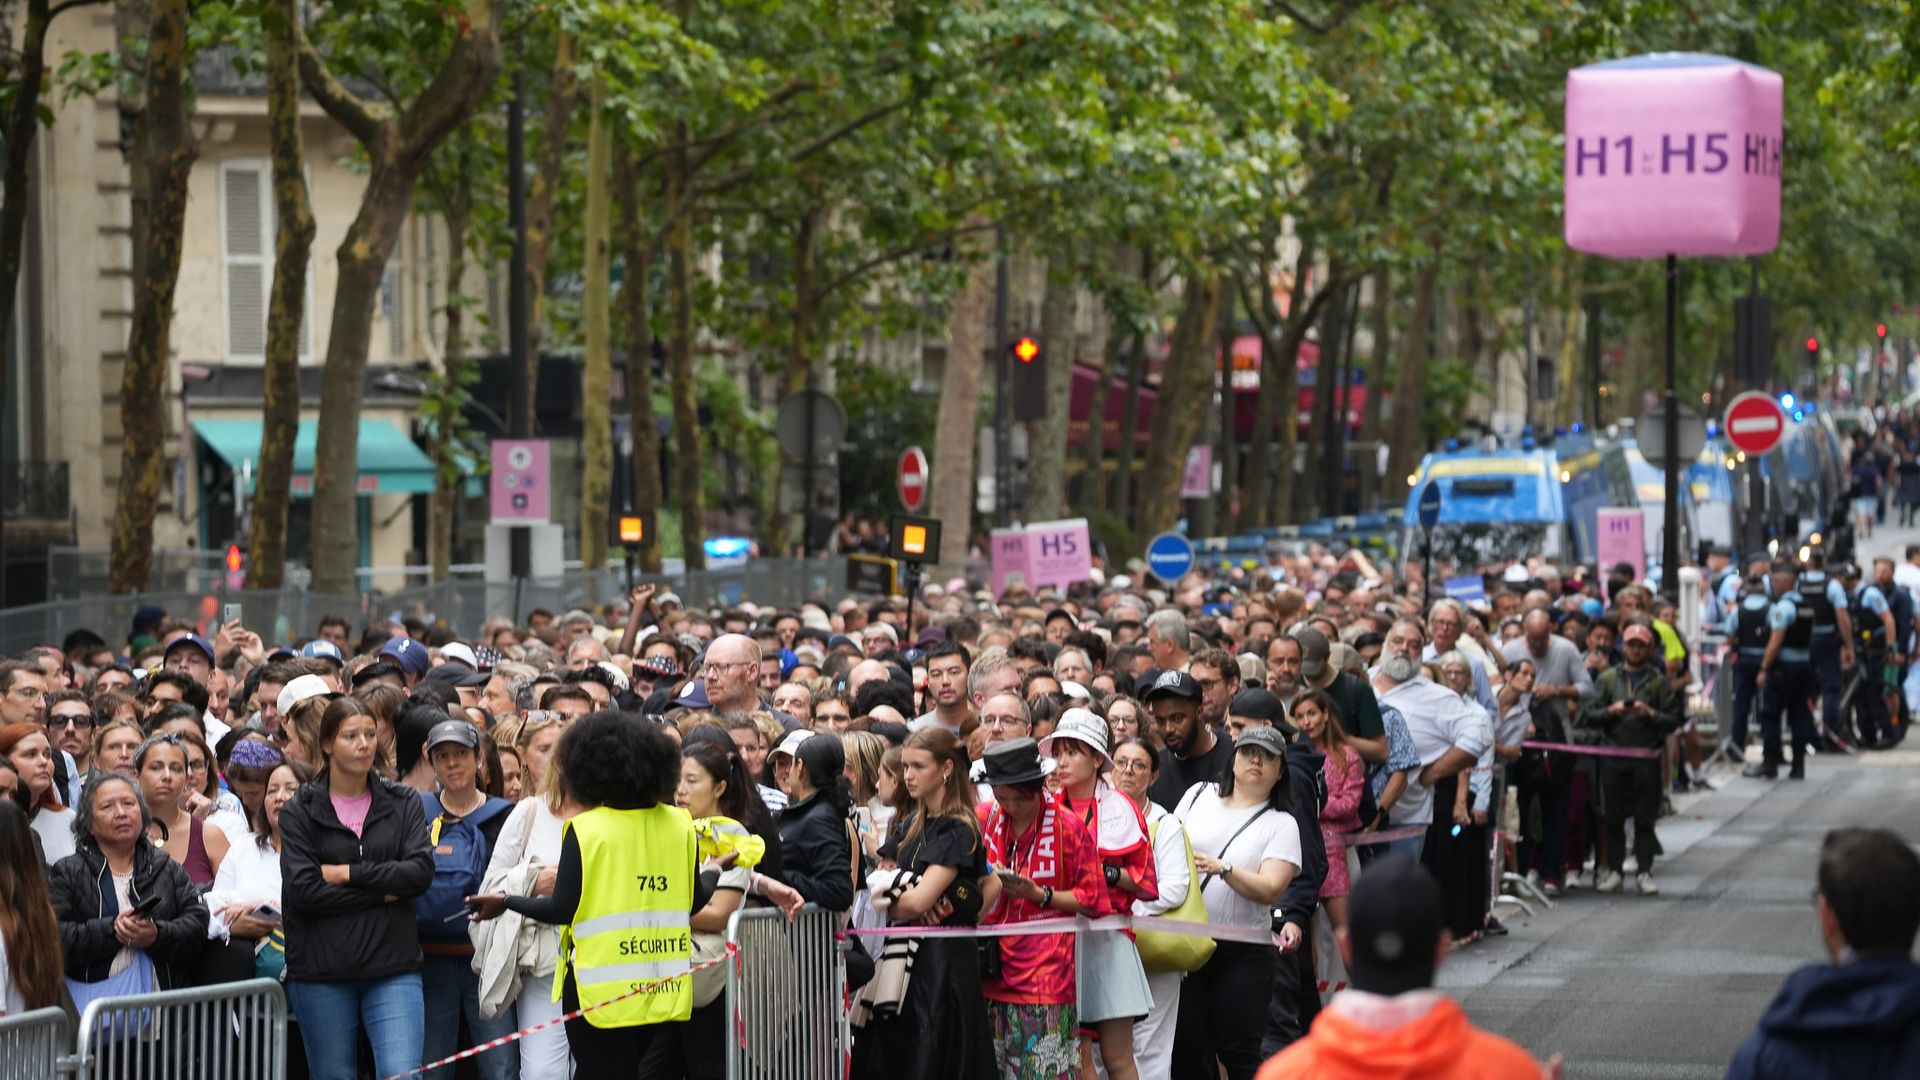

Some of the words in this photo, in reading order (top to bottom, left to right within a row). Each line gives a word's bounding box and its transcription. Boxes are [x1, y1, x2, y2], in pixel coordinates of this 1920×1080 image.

[1576, 136, 1633, 176] H1
[1661, 133, 1728, 174] H5
[1041, 532, 1077, 557] H5
[1032, 809, 1056, 889] EAM
[637, 875, 668, 892] 743
[619, 933, 688, 955] SÉCURITÉ
